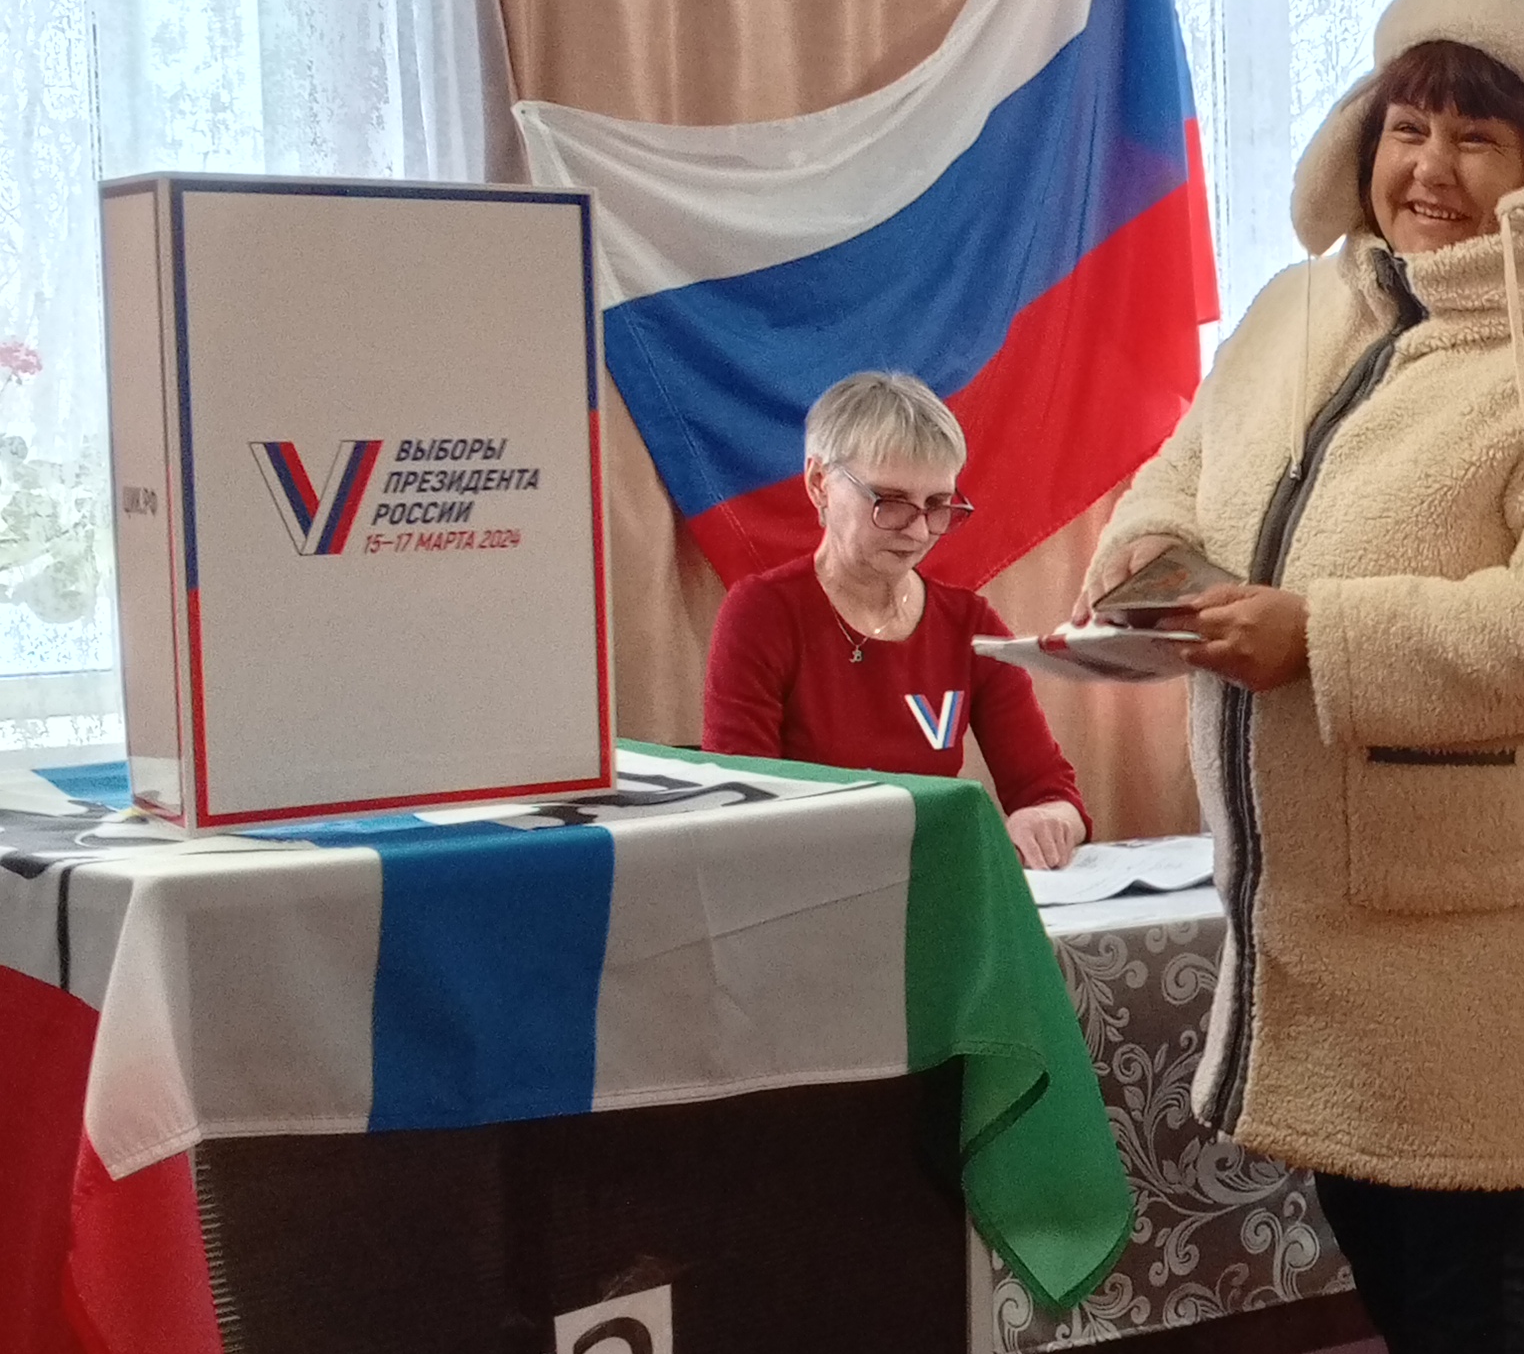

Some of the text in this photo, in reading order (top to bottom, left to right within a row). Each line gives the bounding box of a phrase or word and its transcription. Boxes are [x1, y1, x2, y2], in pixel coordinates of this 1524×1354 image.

[395, 437, 508, 462] ВЫБОРЫ
[384, 468, 541, 495] ПРЕЗИДЕНТА
[371, 501, 475, 526] РОССИИ
[414, 531, 475, 552] МАРТА
[477, 528, 522, 550] 2024
